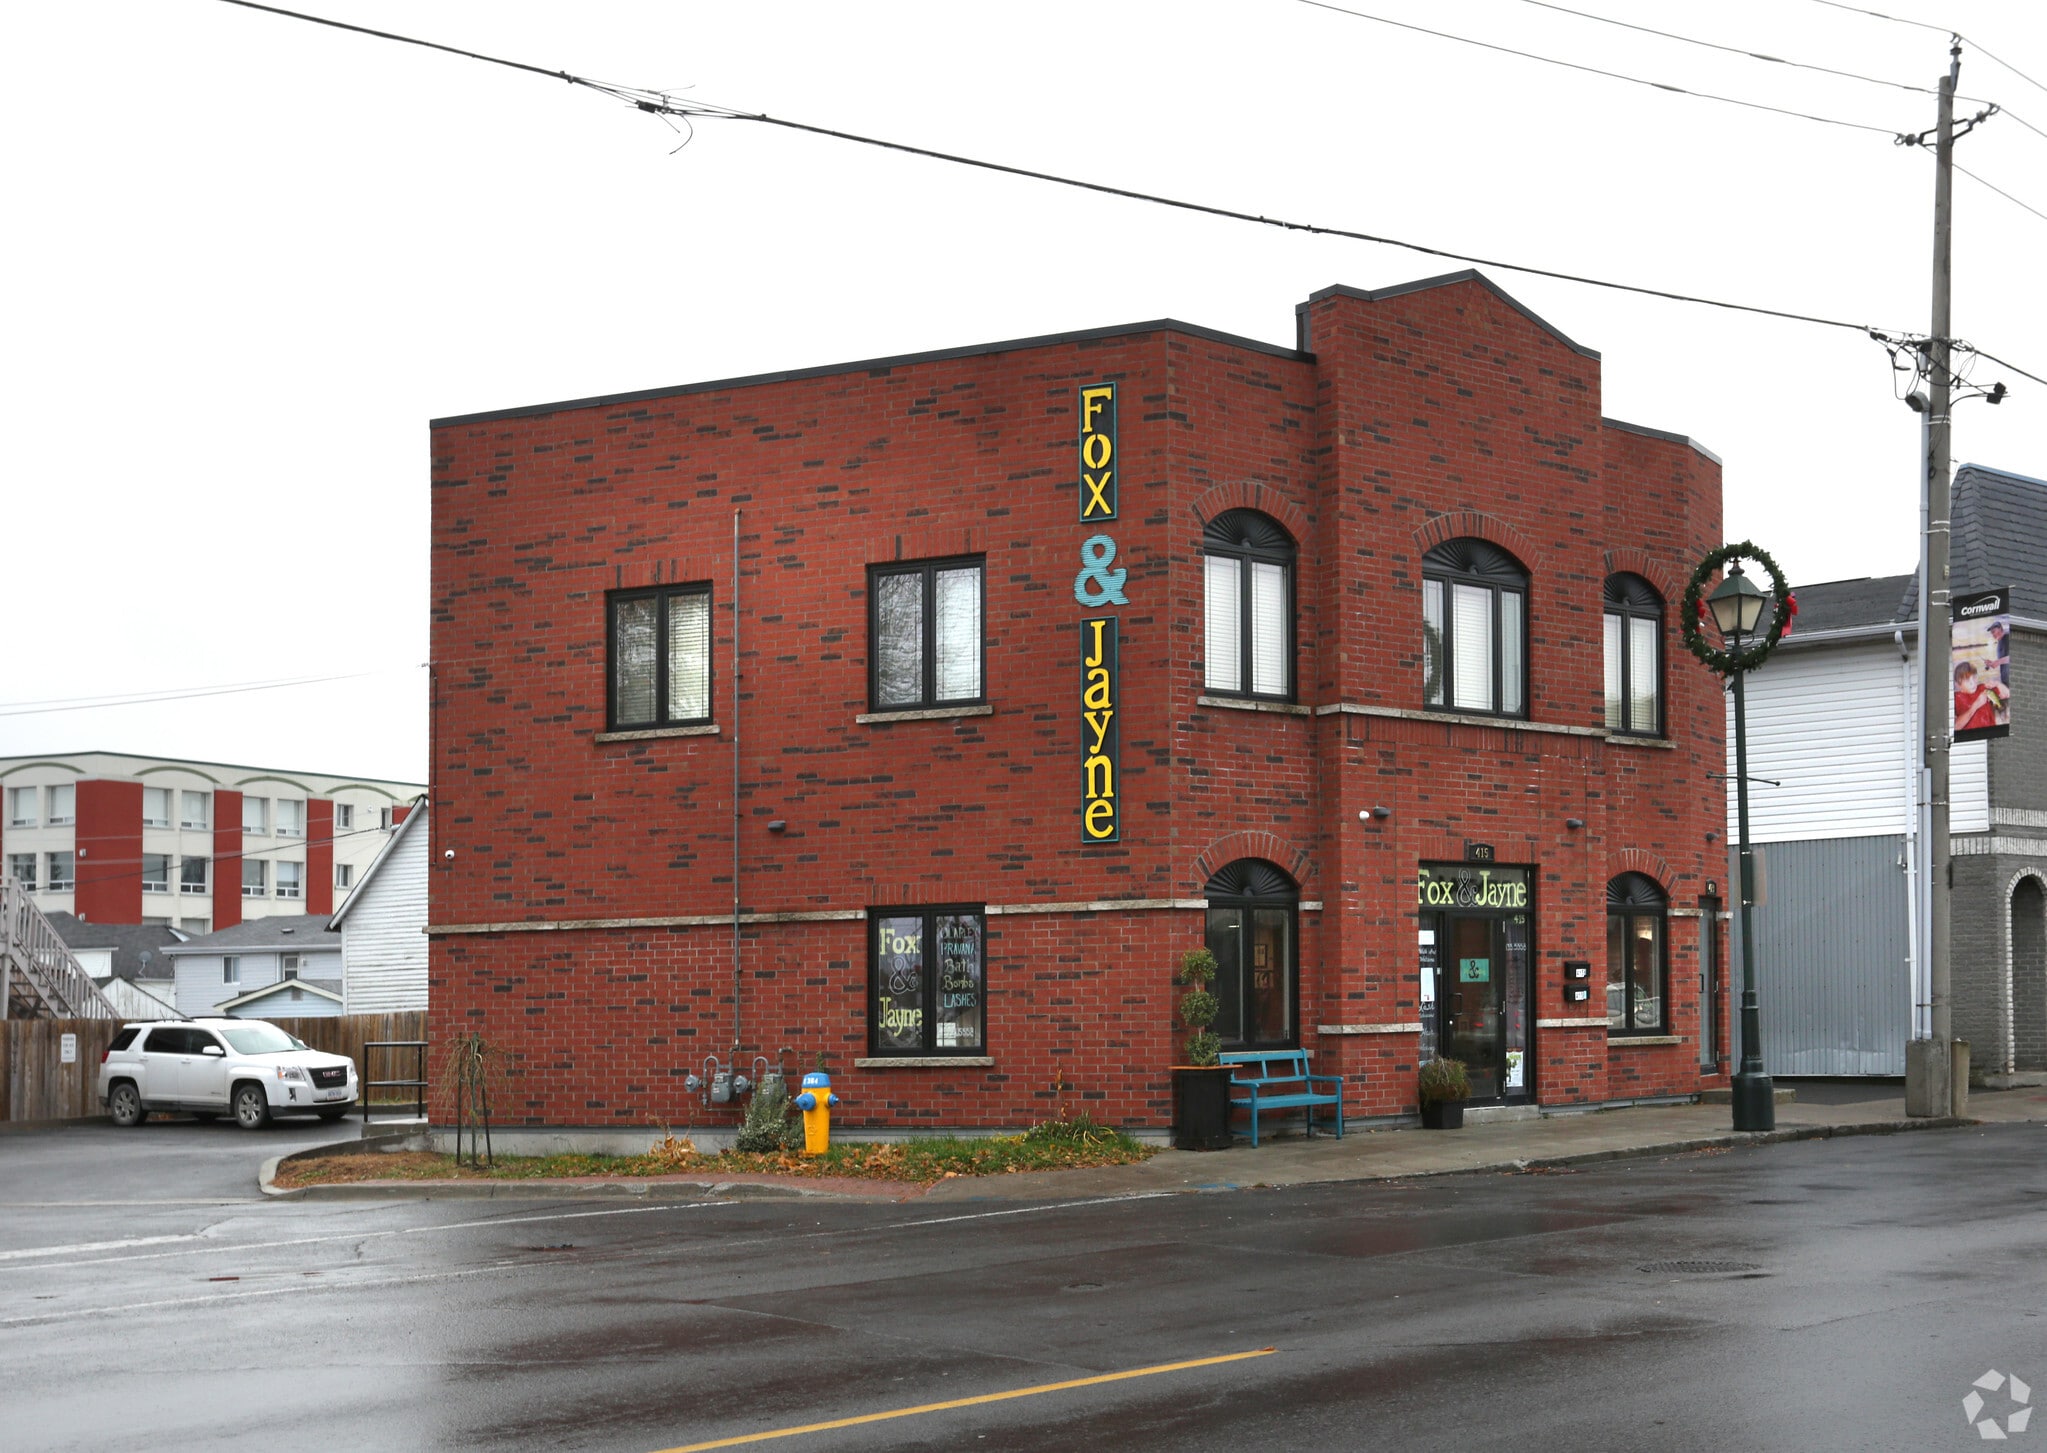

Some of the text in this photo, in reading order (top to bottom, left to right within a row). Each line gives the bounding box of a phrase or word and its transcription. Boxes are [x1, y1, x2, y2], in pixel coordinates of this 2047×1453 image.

[1074, 535, 1130, 607] &
[1084, 621, 1114, 838] Jayne
[1475, 847, 1489, 859] 415
[1418, 869, 1454, 905] Fox
[1475, 870, 1527, 908] Jayne
[880, 928, 921, 955] Fox
[879, 997, 923, 1037] Jayne
[944, 992, 977, 1008] LASHES
